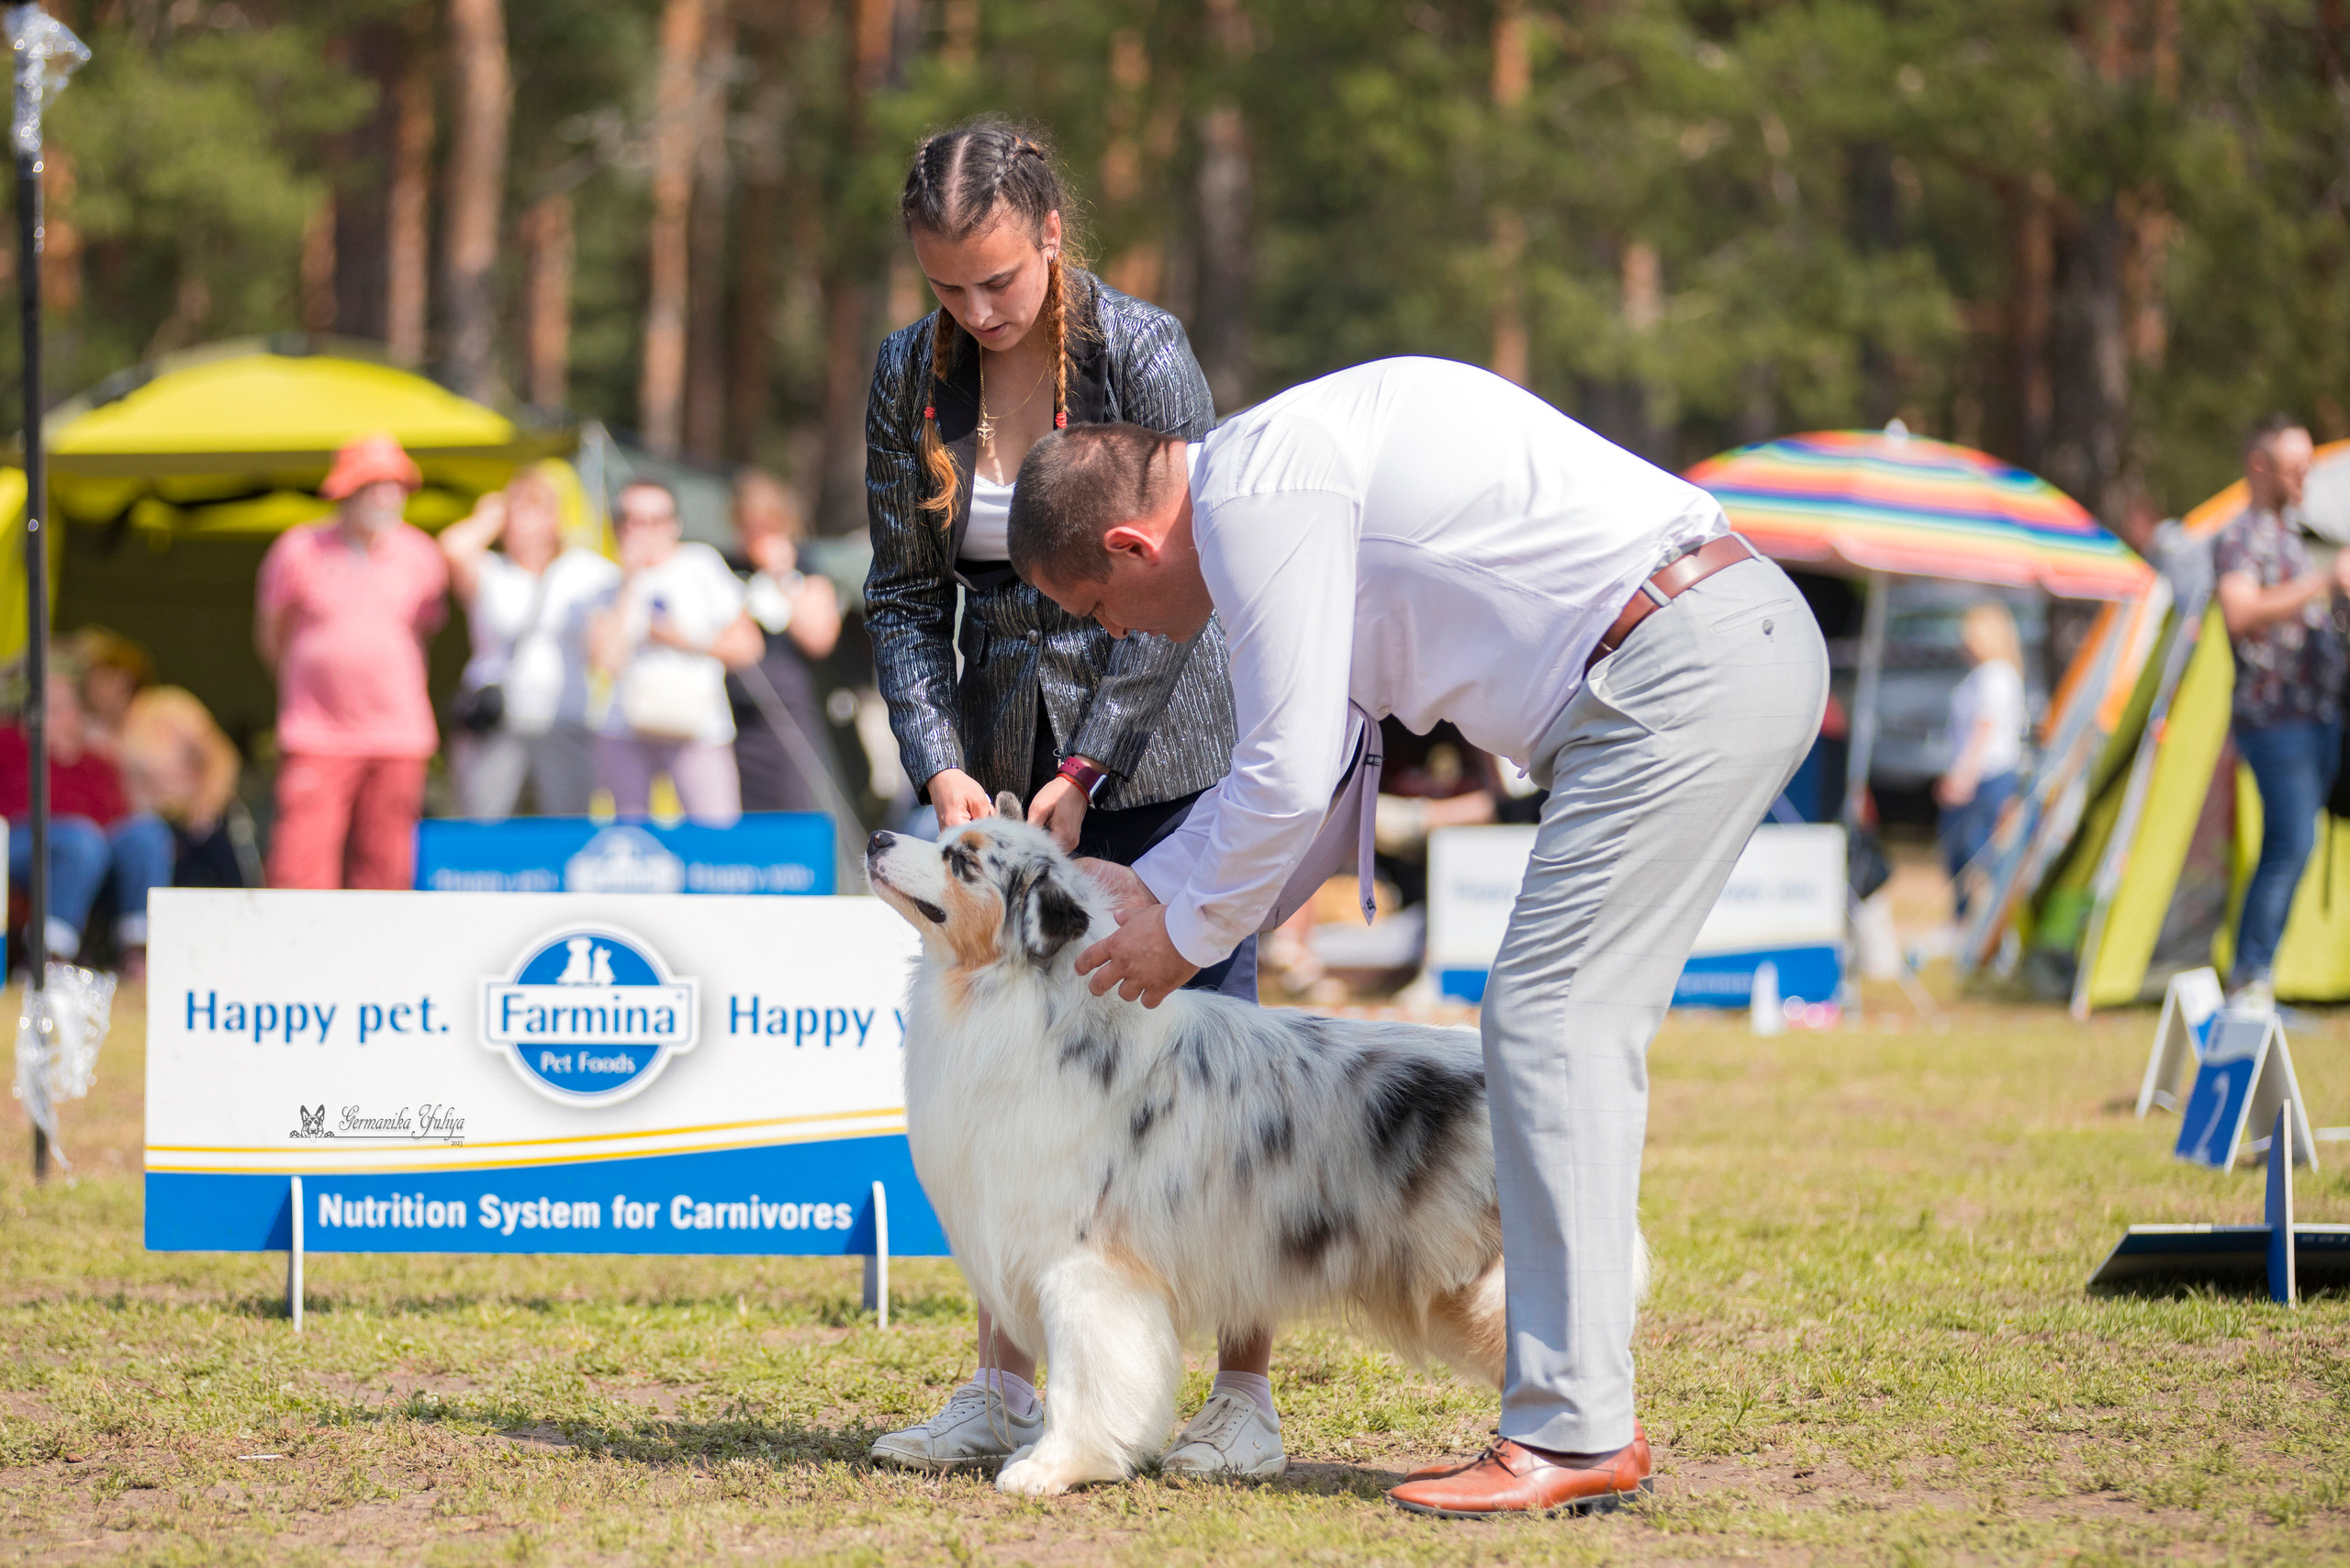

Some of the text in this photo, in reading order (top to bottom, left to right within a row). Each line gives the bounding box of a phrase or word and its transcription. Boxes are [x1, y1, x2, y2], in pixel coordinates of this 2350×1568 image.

[186, 991, 449, 1044] Happy pet.
[500, 992, 676, 1034] Farmina
[730, 994, 875, 1047] Happy
[540, 1051, 636, 1074] Pet Foods
[319, 1193, 853, 1236] Nutrition System for Carnivores
